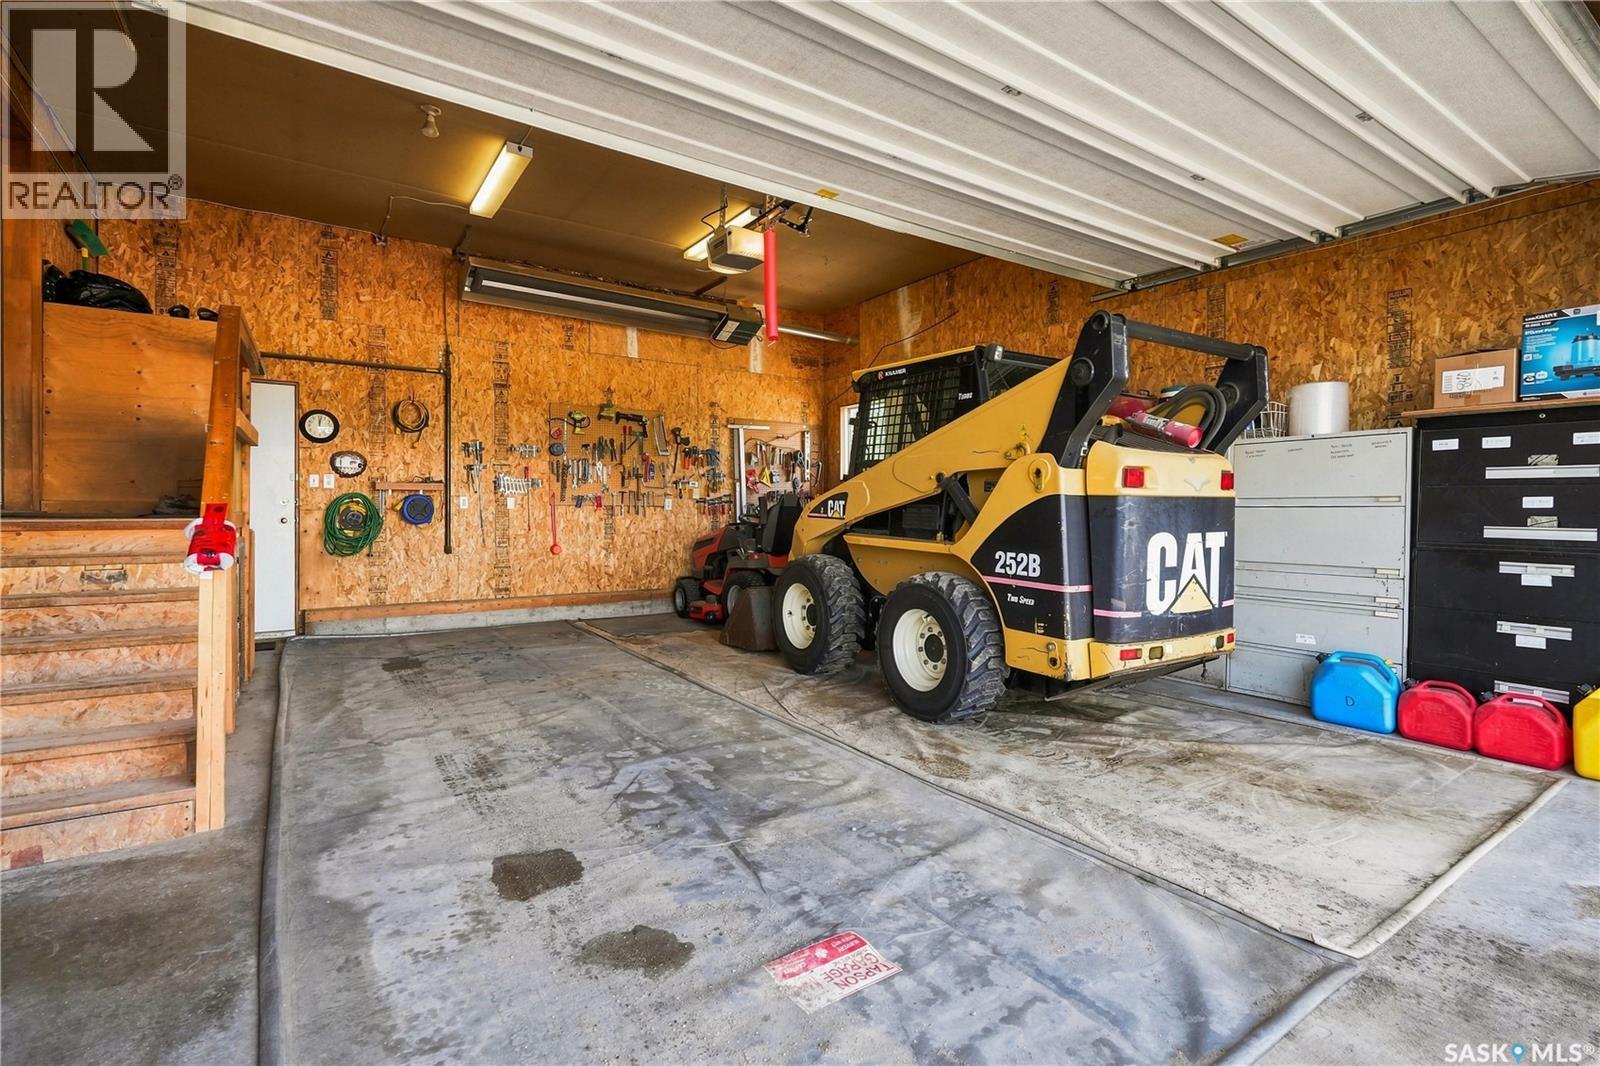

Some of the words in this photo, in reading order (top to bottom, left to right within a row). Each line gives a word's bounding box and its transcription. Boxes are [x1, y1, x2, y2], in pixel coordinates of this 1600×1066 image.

[827, 500, 846, 518] CAT
[995, 551, 1041, 577] 252B
[1146, 531, 1226, 615] CAT
[822, 952, 880, 983] GARAGE
